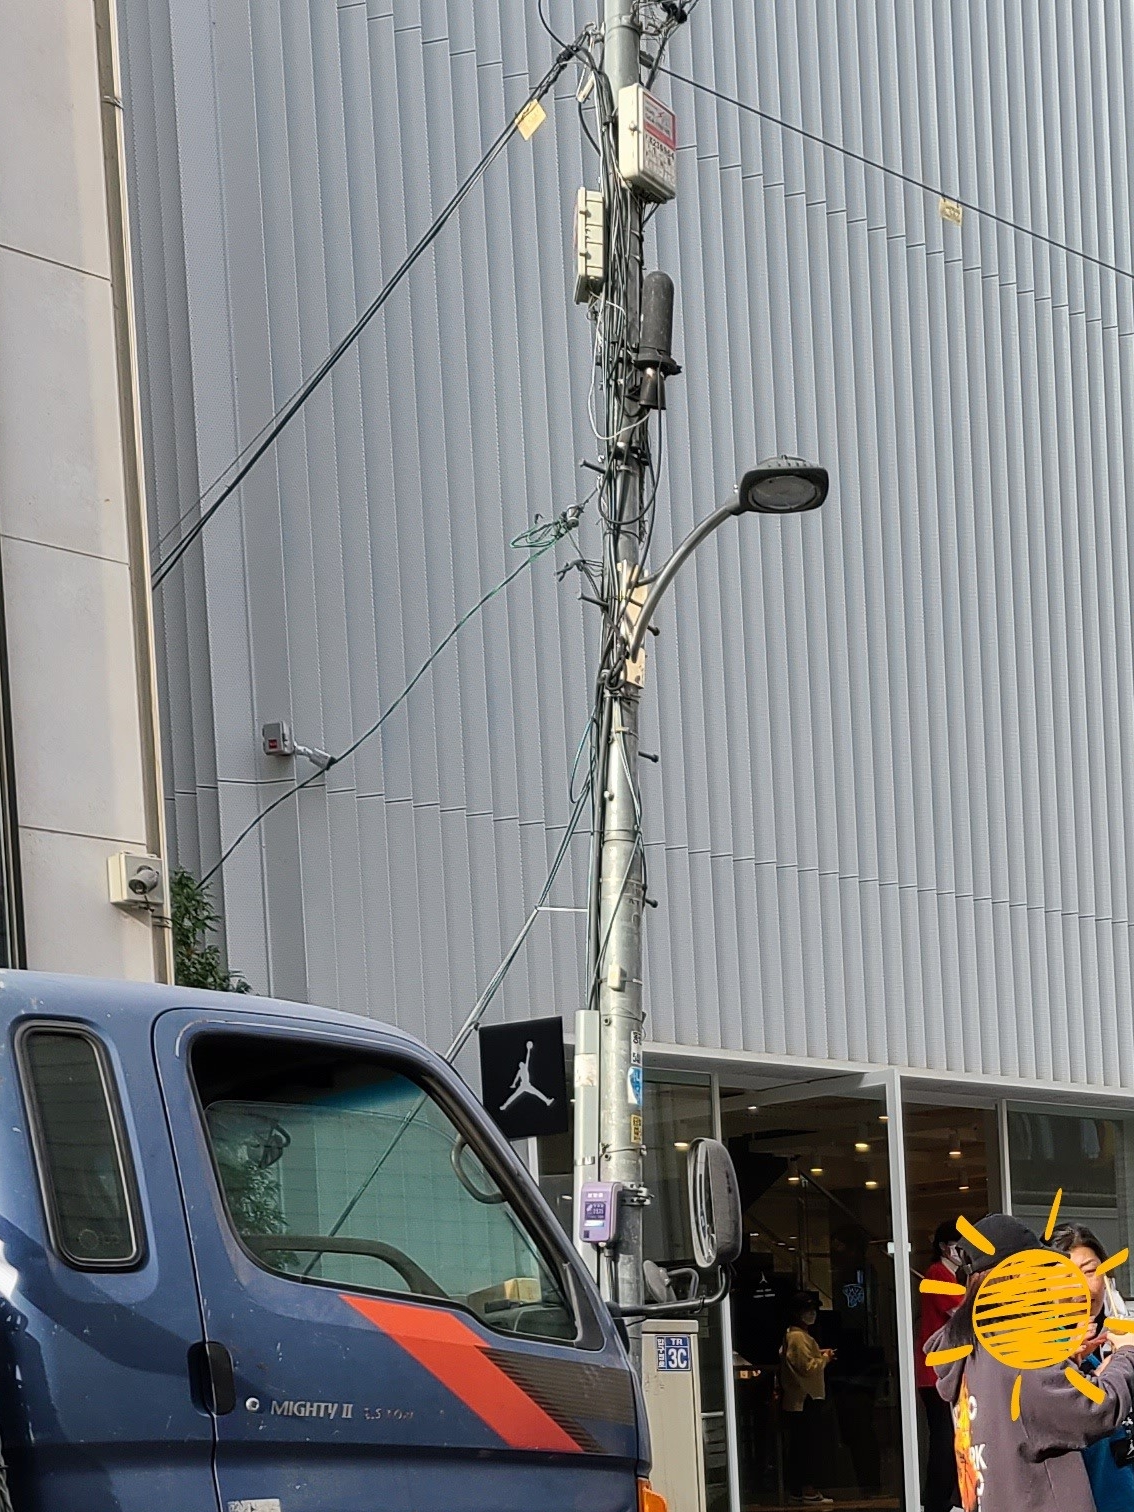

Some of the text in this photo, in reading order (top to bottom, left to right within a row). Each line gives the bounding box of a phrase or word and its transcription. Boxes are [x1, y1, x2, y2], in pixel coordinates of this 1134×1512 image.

[669, 1338, 683, 1346] TR
[667, 1347, 688, 1369] 3C
[270, 1400, 338, 1419] MIGHTY
